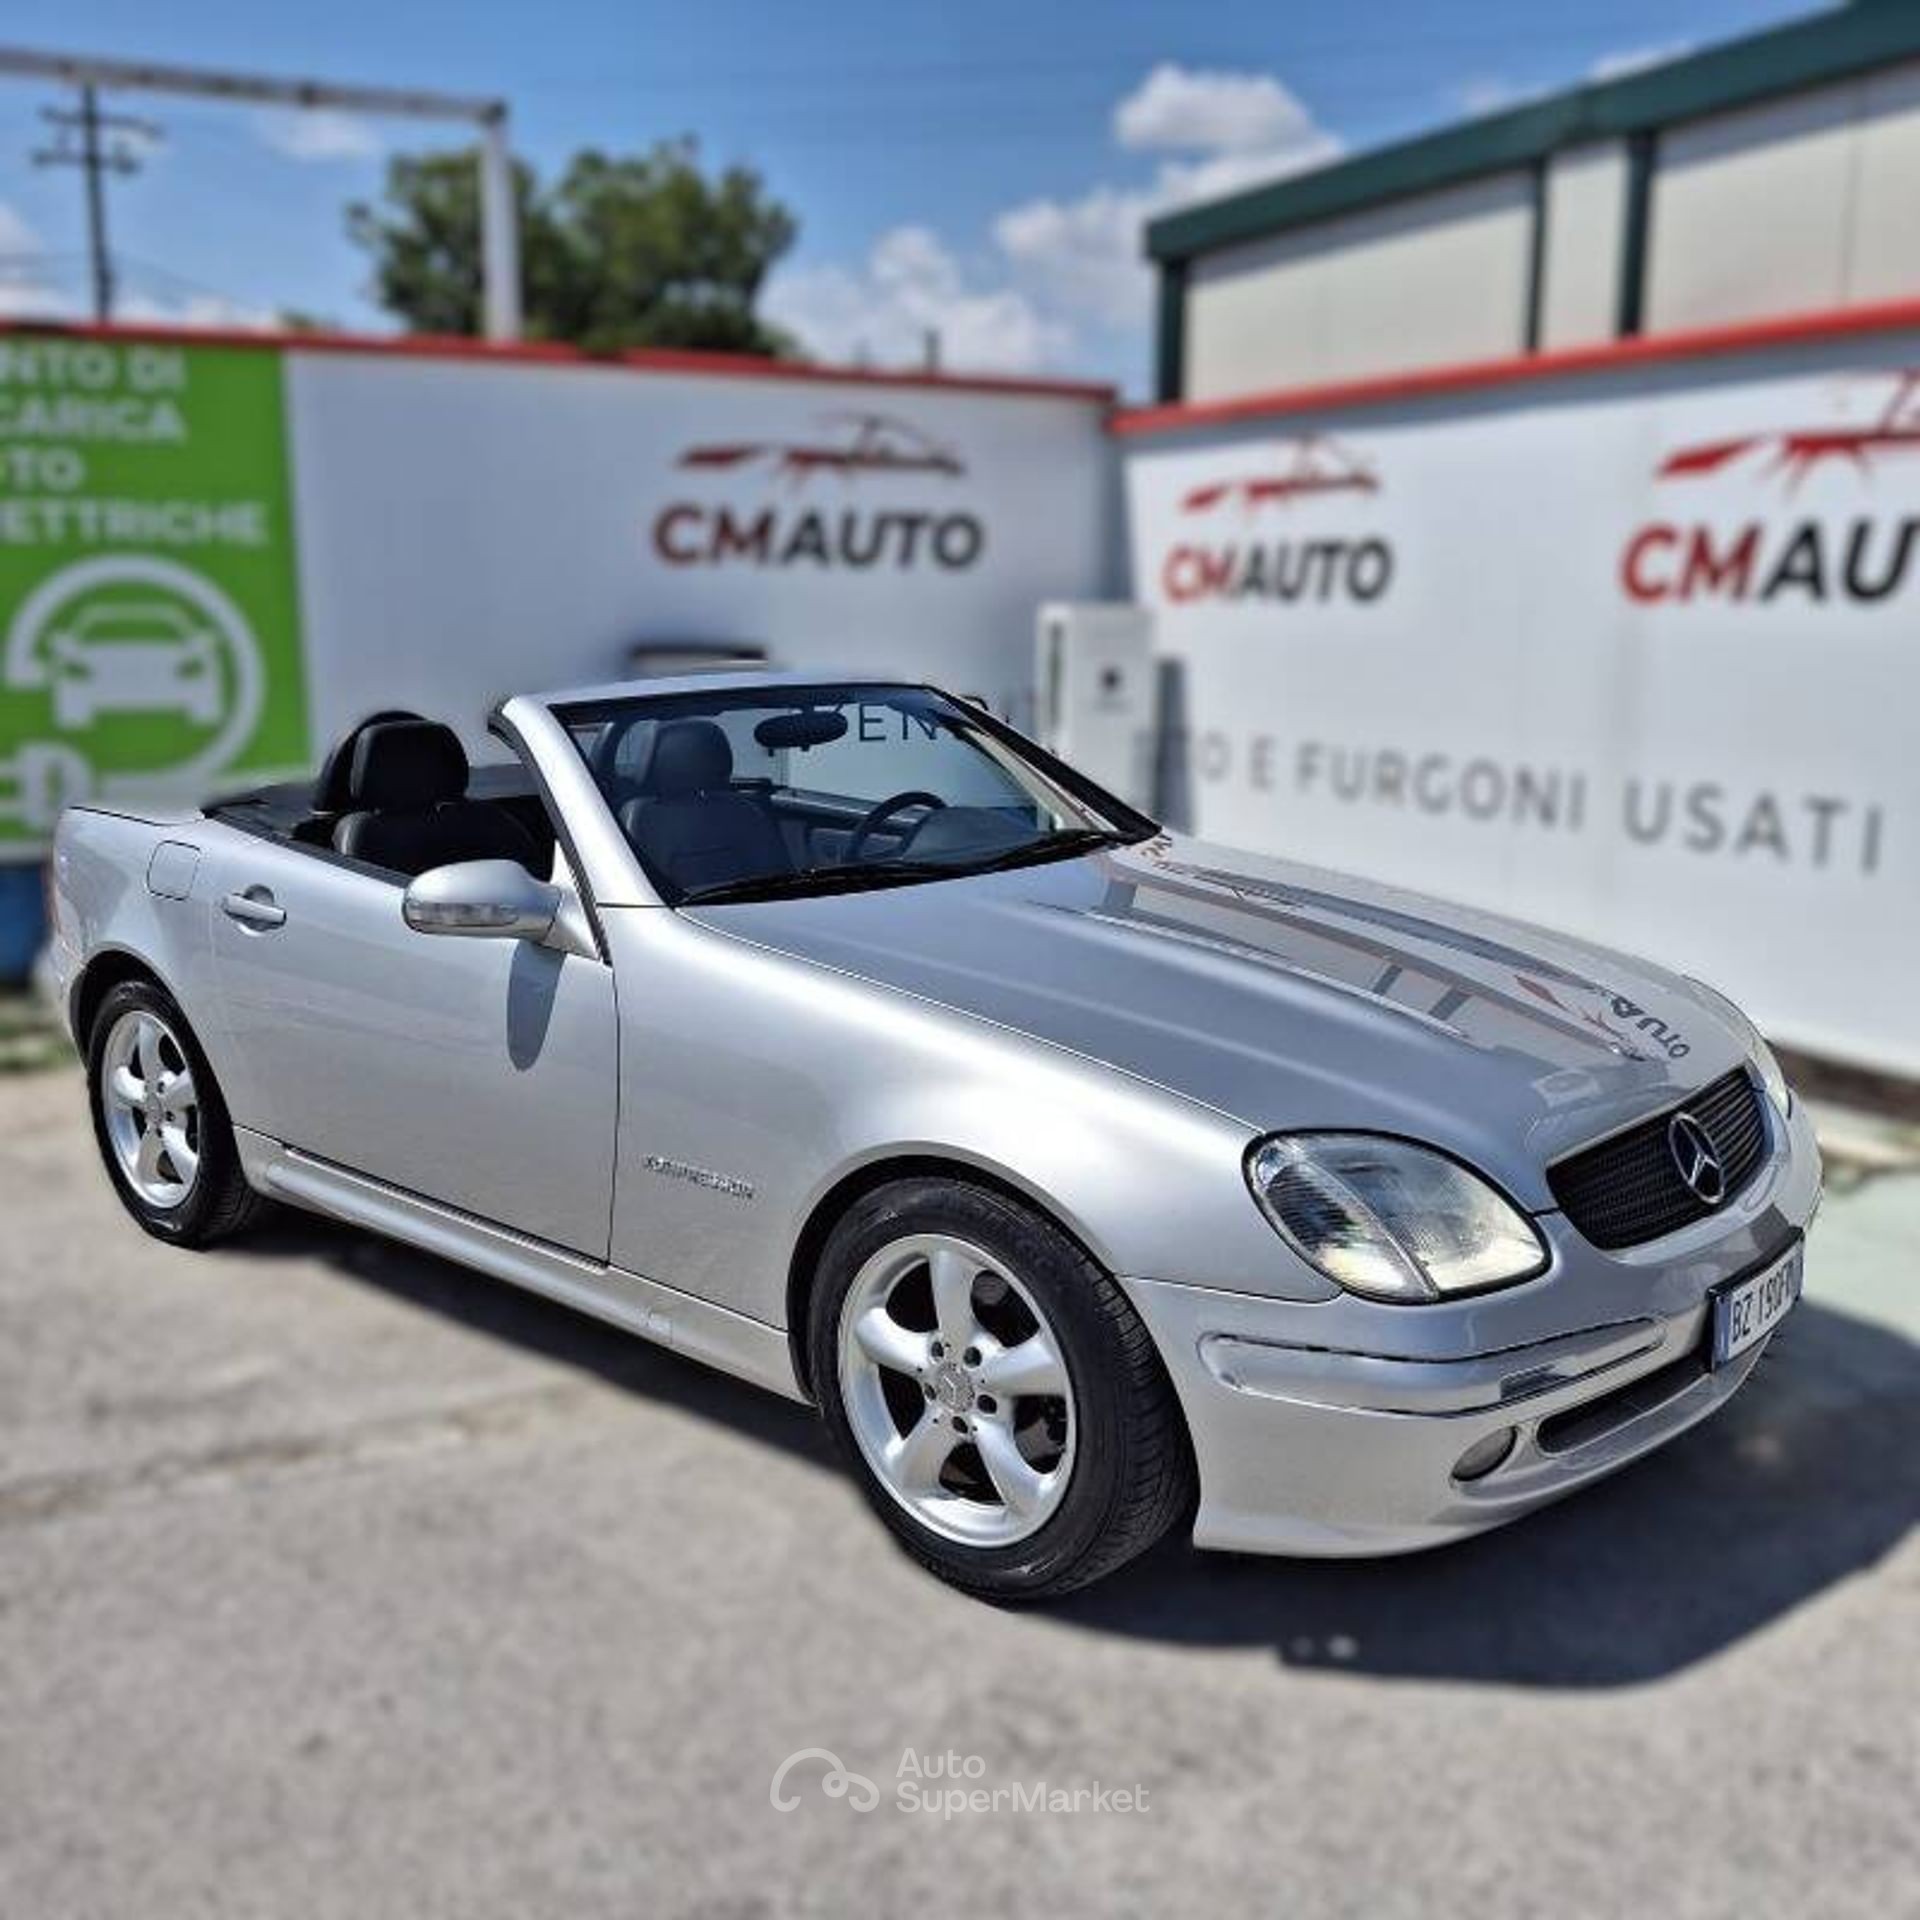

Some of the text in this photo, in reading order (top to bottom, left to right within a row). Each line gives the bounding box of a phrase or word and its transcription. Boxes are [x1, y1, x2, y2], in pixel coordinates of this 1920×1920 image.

[0, 446, 84, 493] TO
[652, 503, 984, 569] CMAUTO
[1162, 536, 1396, 604] CMAUTO
[1617, 515, 1920, 607] CMAU
[1250, 733, 1276, 793] E
[1295, 740, 1588, 832] FURGONI
[1622, 779, 1885, 876] USATI
